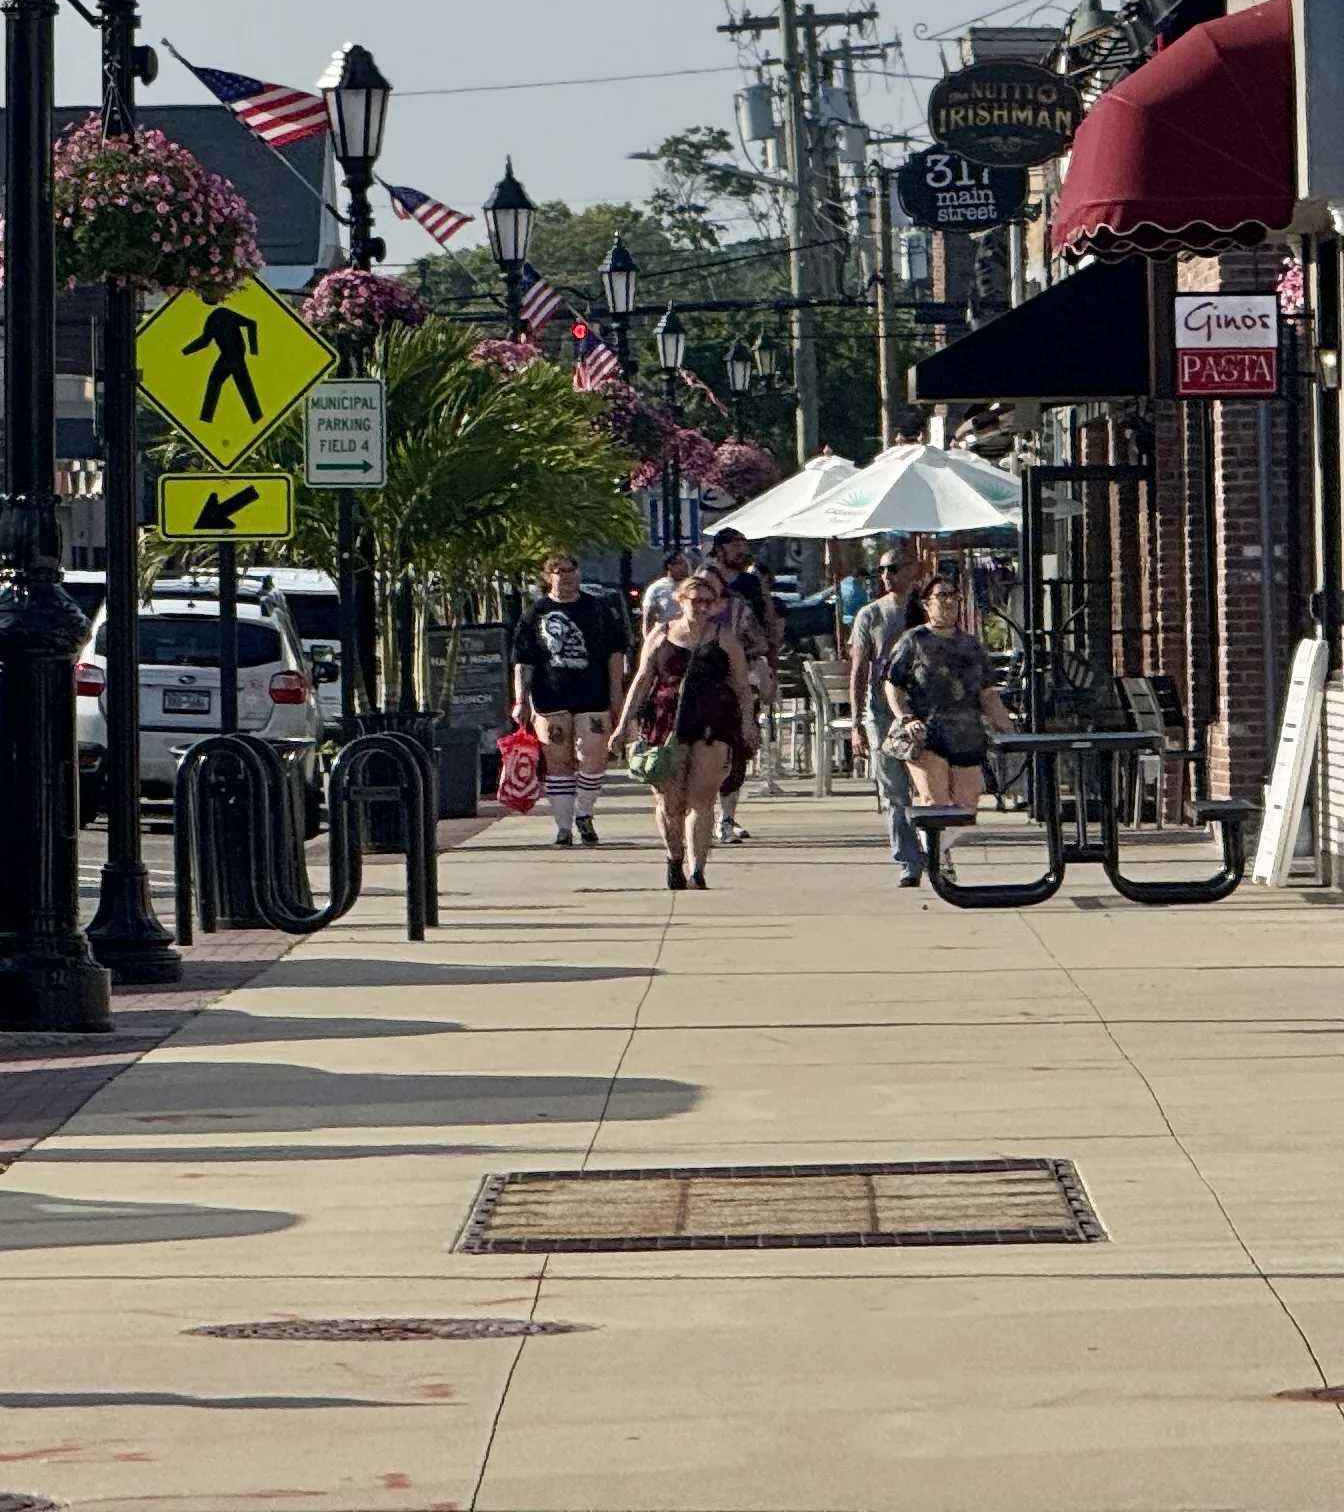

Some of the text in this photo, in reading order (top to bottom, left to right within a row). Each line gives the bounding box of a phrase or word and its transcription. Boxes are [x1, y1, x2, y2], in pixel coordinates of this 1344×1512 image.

[939, 102, 1073, 136] IRISHMAN
[936, 187, 996, 206] main
[937, 205, 998, 222] street
[1184, 301, 1270, 342] Gino's
[1183, 355, 1272, 383] PASTA
[310, 396, 377, 410] MUNICIPAL
[317, 417, 371, 431] PARKING
[319, 439, 369, 453] FIELD 4
